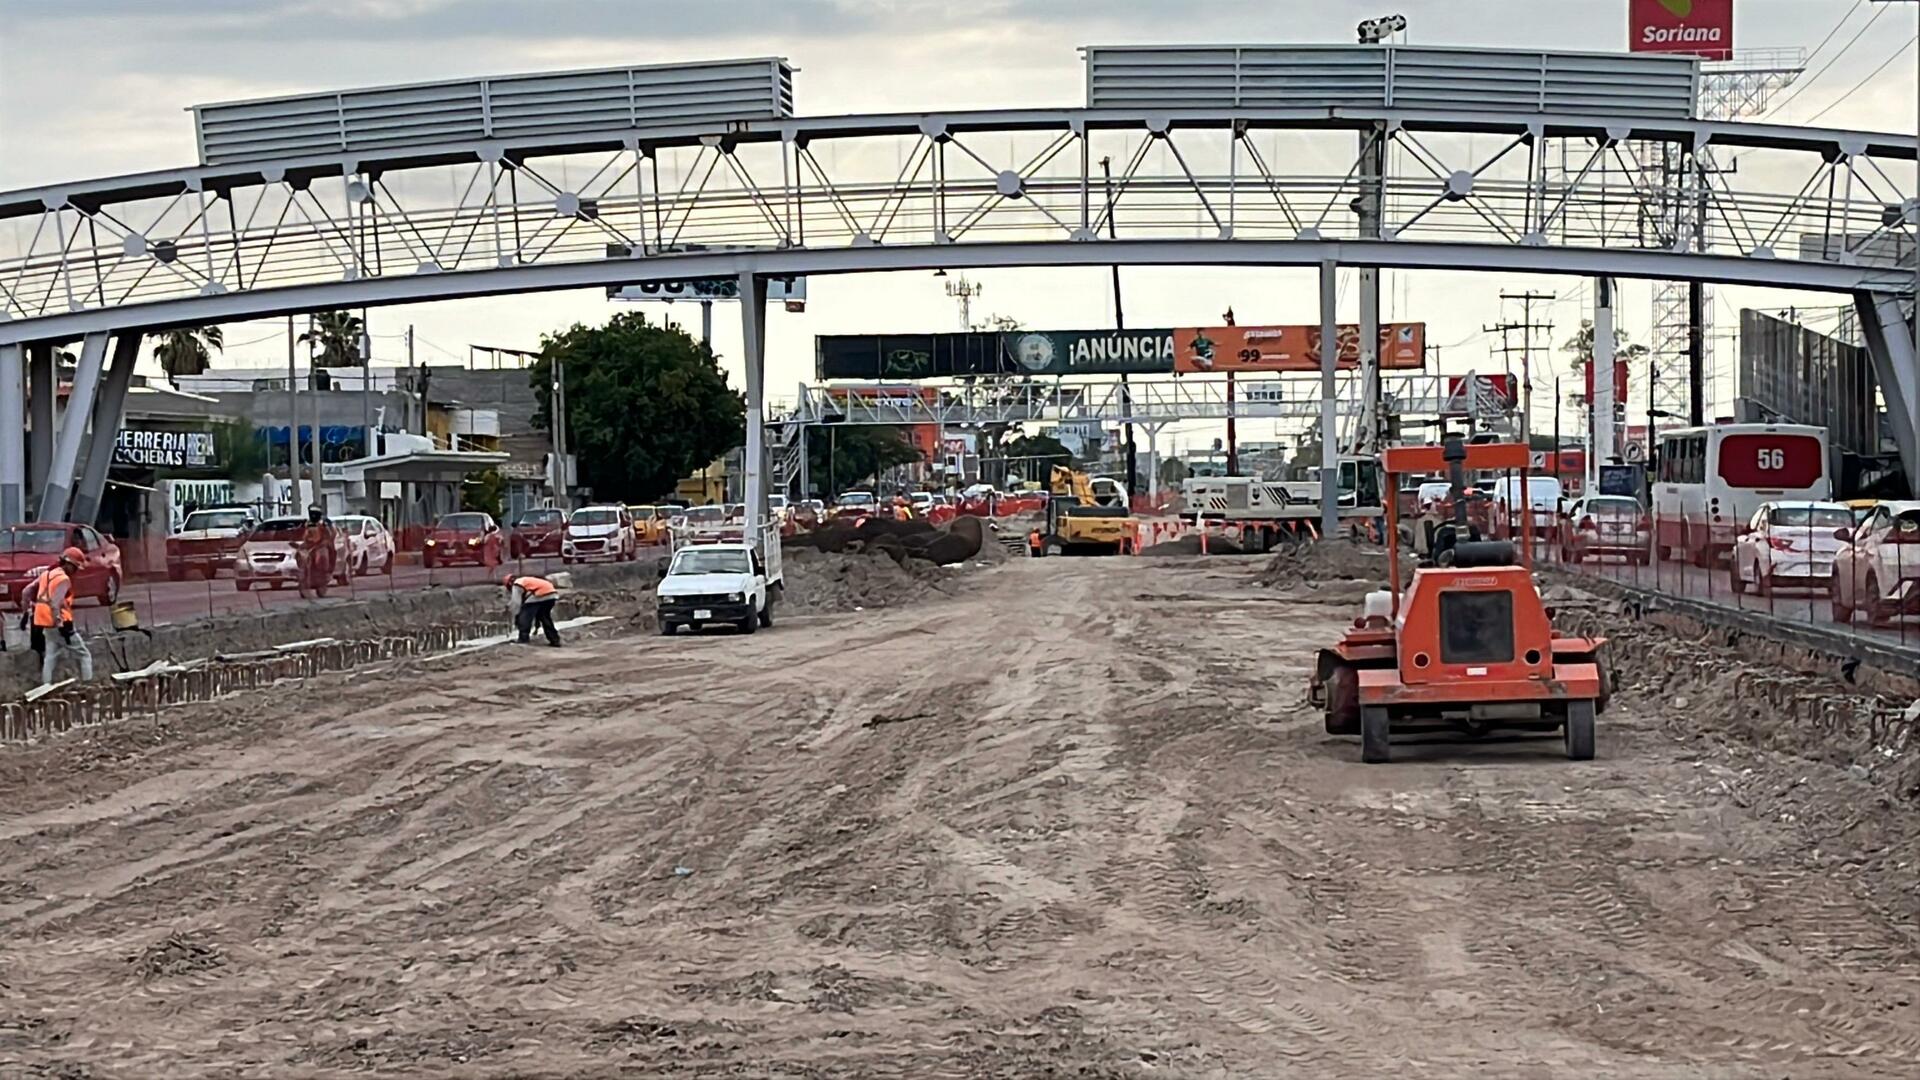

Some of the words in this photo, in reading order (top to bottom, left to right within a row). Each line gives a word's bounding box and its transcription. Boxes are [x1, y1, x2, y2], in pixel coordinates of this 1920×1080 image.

[1643, 24, 1721, 43] Soriana
[1757, 448, 1784, 470] 56
[175, 484, 236, 506] DIAMANTE
